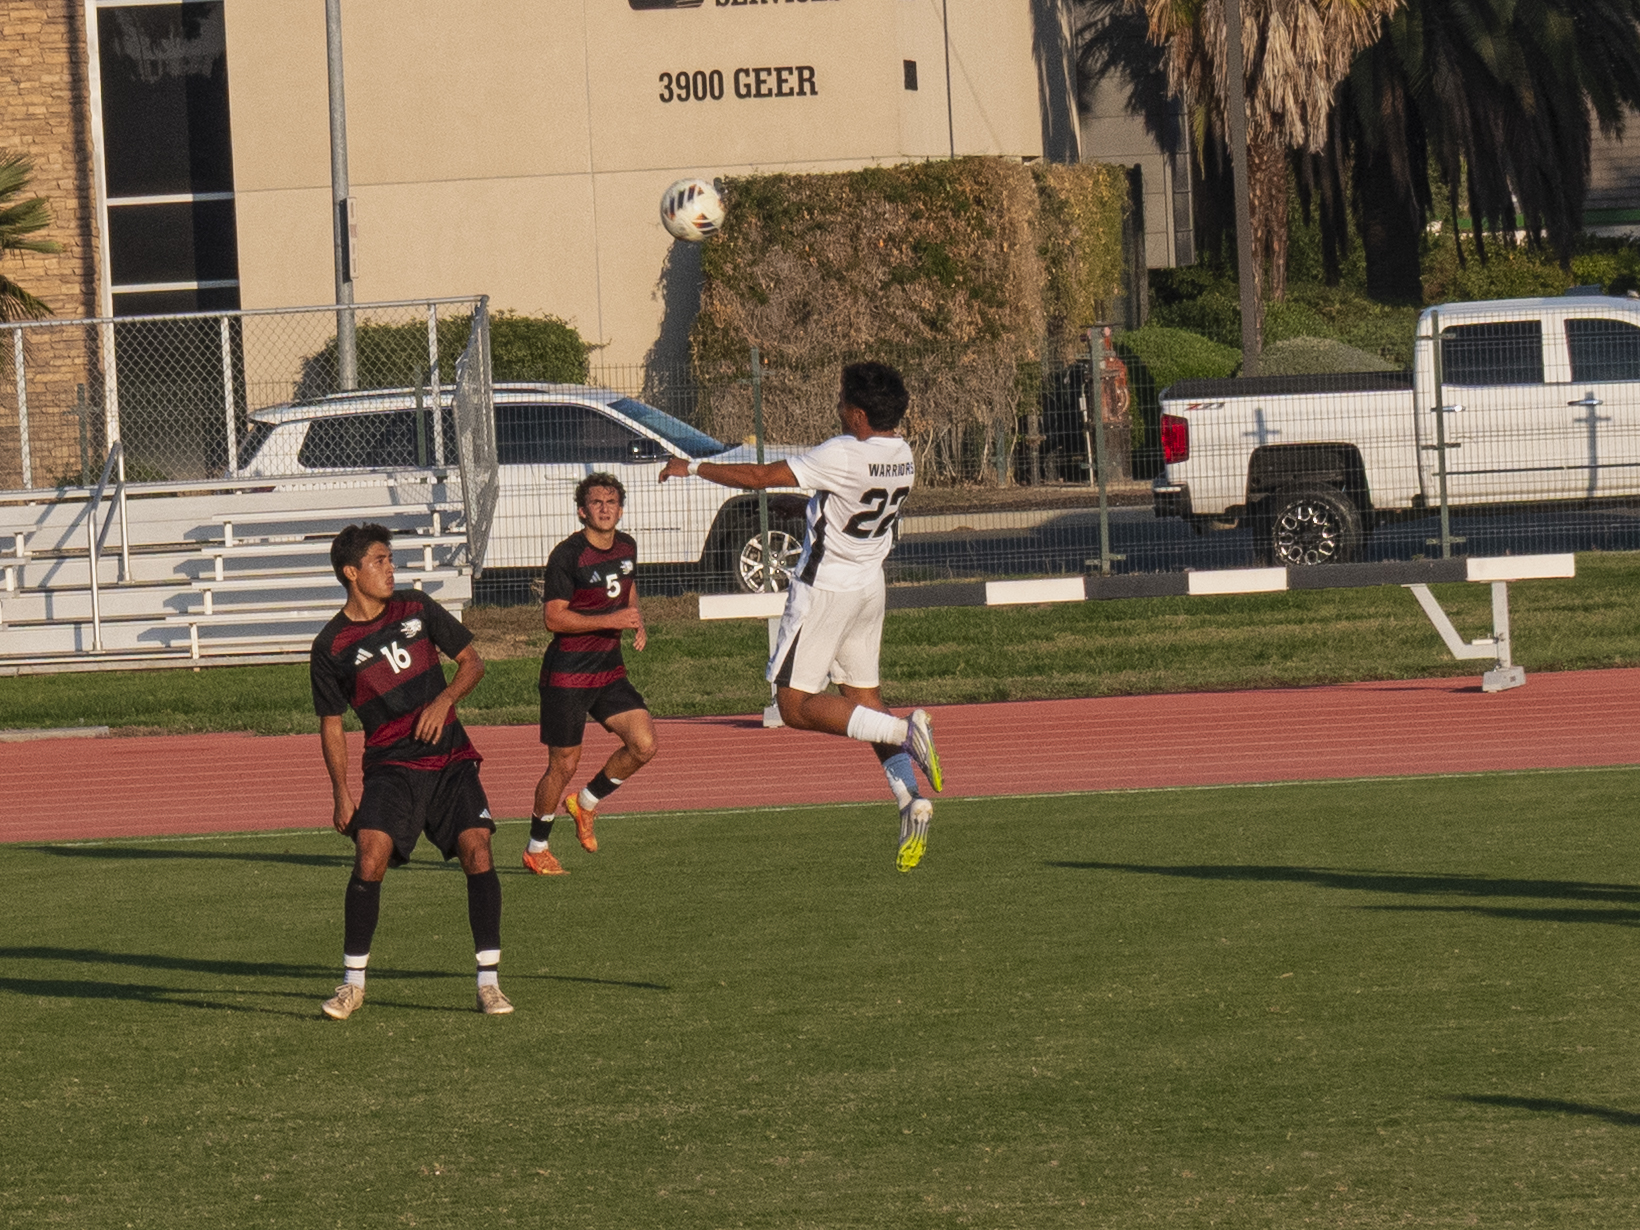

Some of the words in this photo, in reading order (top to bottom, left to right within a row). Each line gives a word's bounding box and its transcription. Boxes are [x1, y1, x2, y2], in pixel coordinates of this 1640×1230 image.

[658, 69, 724, 103] 3900
[733, 65, 818, 99] GEER
[841, 486, 910, 539] 22
[605, 573, 621, 599] 5
[380, 641, 411, 674] 16
